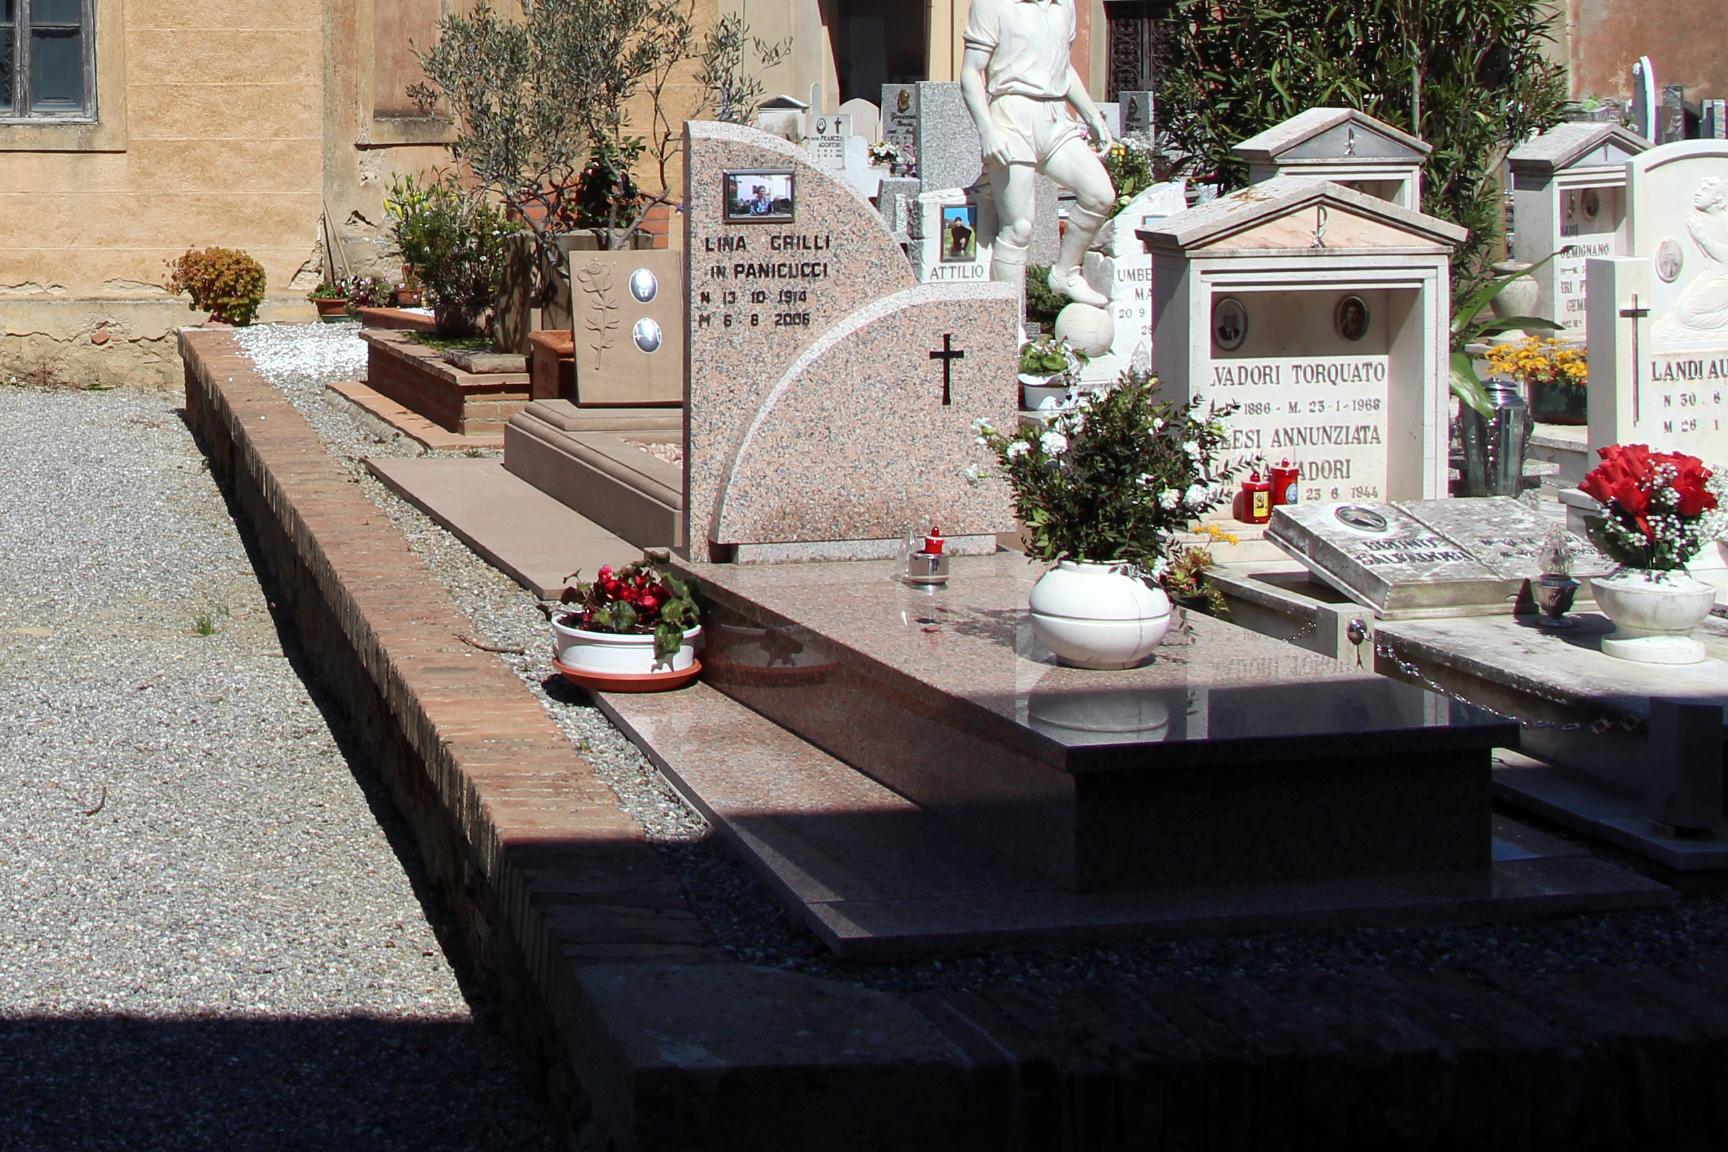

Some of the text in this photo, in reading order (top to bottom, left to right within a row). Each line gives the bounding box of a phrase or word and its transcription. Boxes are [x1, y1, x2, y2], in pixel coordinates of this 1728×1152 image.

[705, 234, 830, 252] LINA GRILLI
[711, 262, 828, 279] IN PANICUCCI
[929, 264, 984, 280] ATTILIO
[700, 291, 710, 304] N
[723, 291, 736, 305] 13
[698, 314, 711, 327] M
[751, 313, 759, 326] 8
[774, 312, 810, 327] 2006
[1118, 308, 1133, 319] 20
[1292, 362, 1386, 385] TORQUATO
[1651, 359, 1703, 382] LANDI
[1270, 424, 1382, 448] ANNUNZIATA
